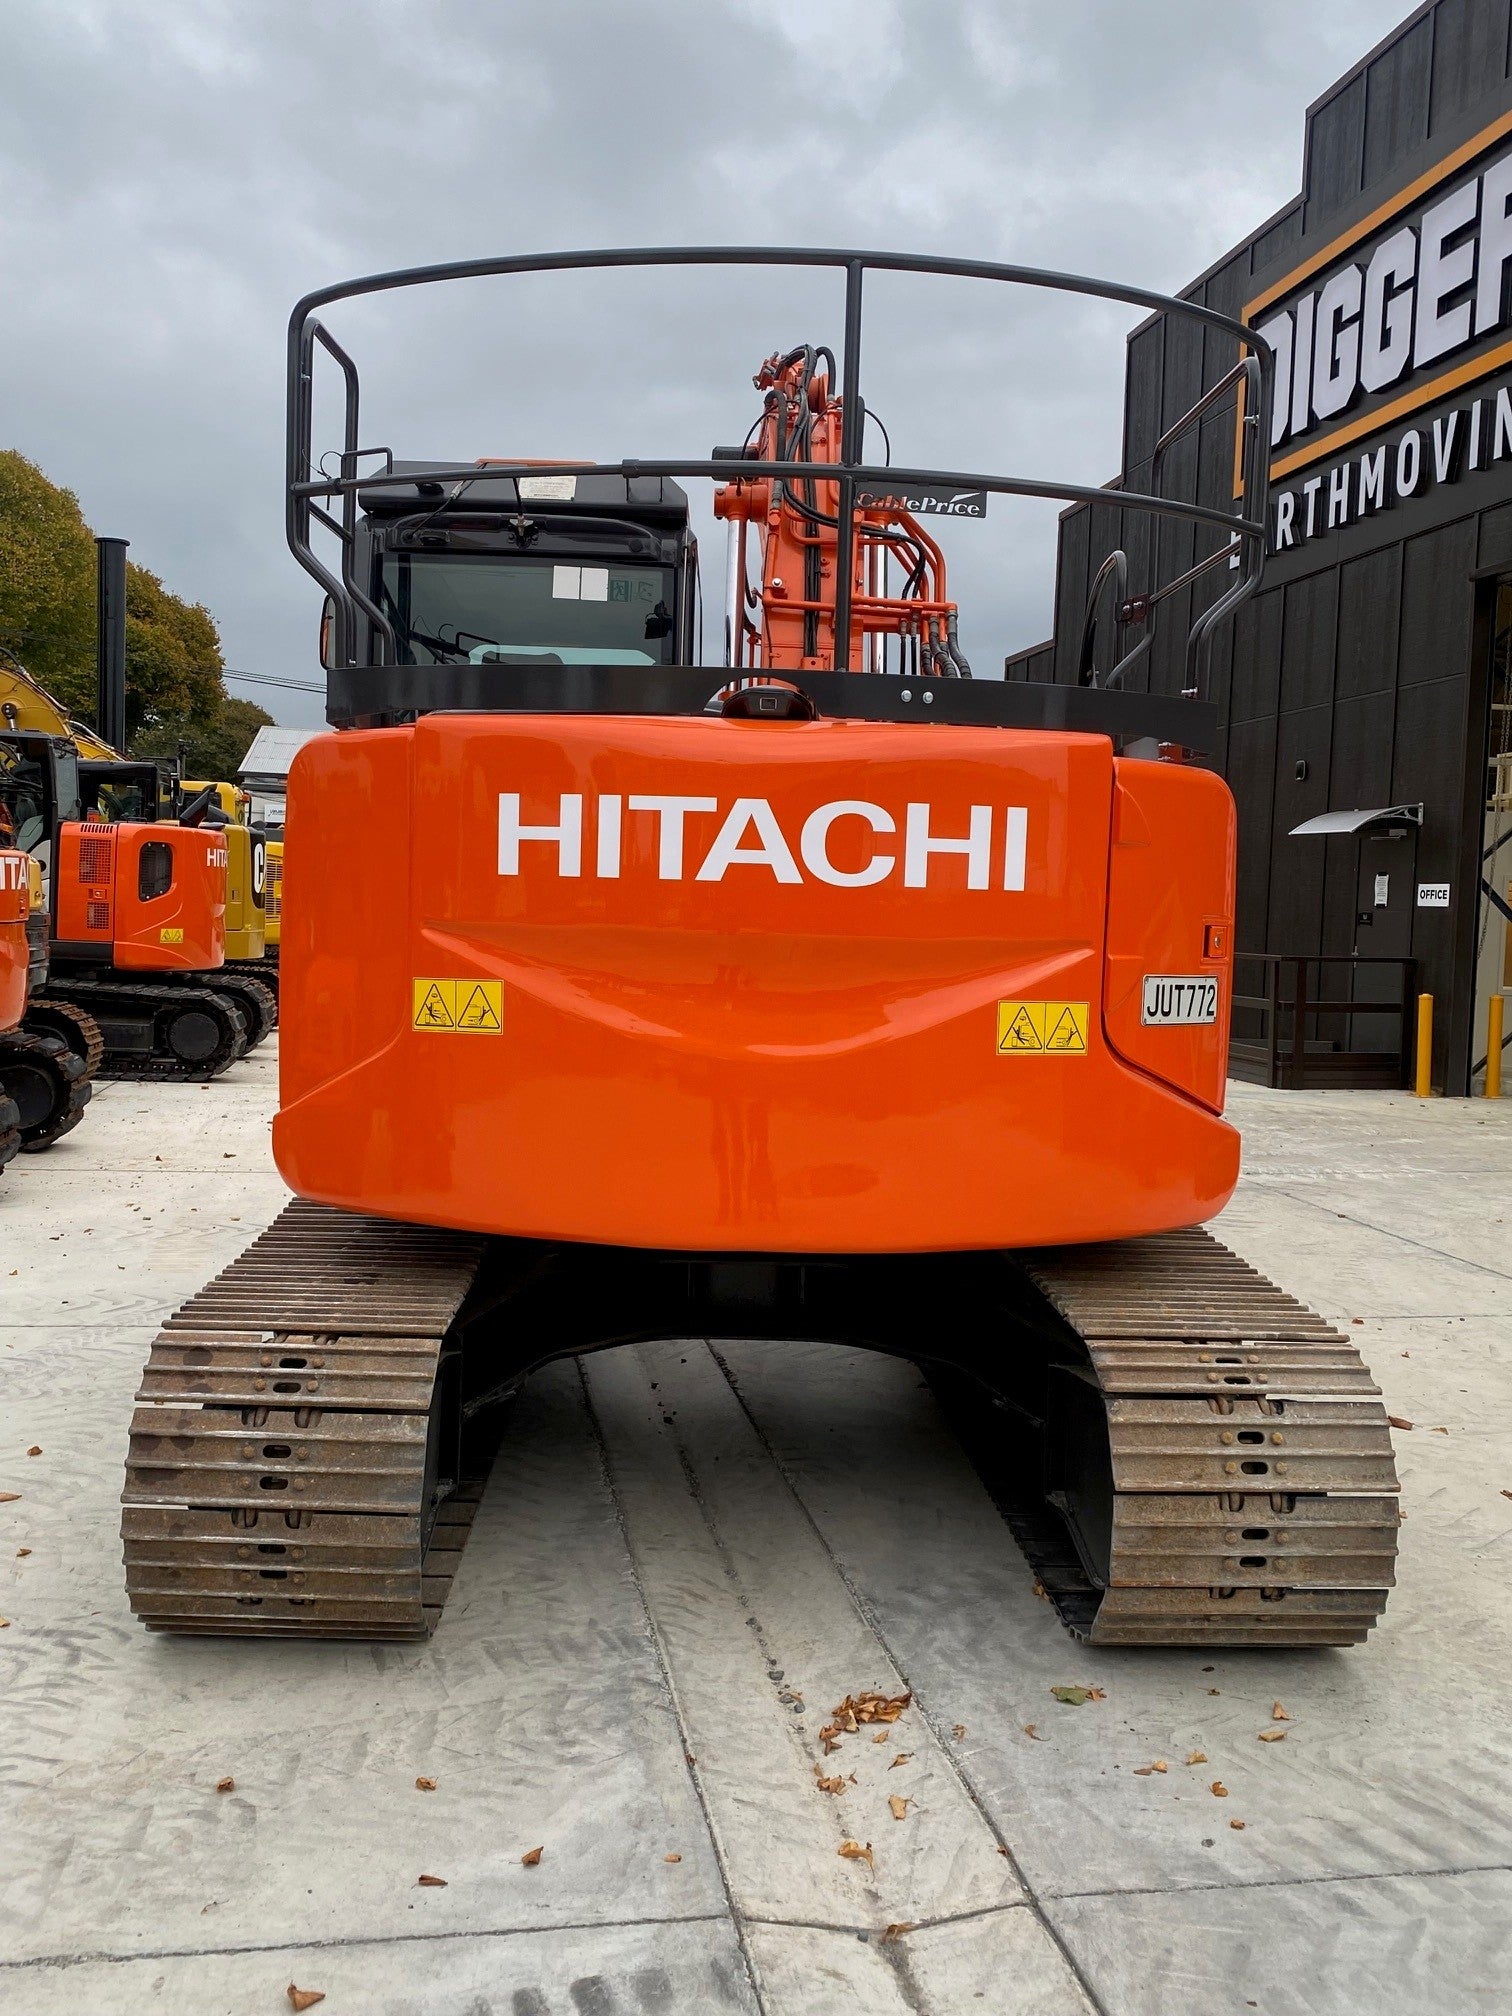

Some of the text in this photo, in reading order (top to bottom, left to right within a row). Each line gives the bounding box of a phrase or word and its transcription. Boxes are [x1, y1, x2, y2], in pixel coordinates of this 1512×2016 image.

[1229, 387, 1512, 570] RTHMOVIN
[497, 793, 1028, 892] HITACHI
[1419, 889, 1448, 900] OFFICE
[1146, 984, 1216, 1017] JUT772
